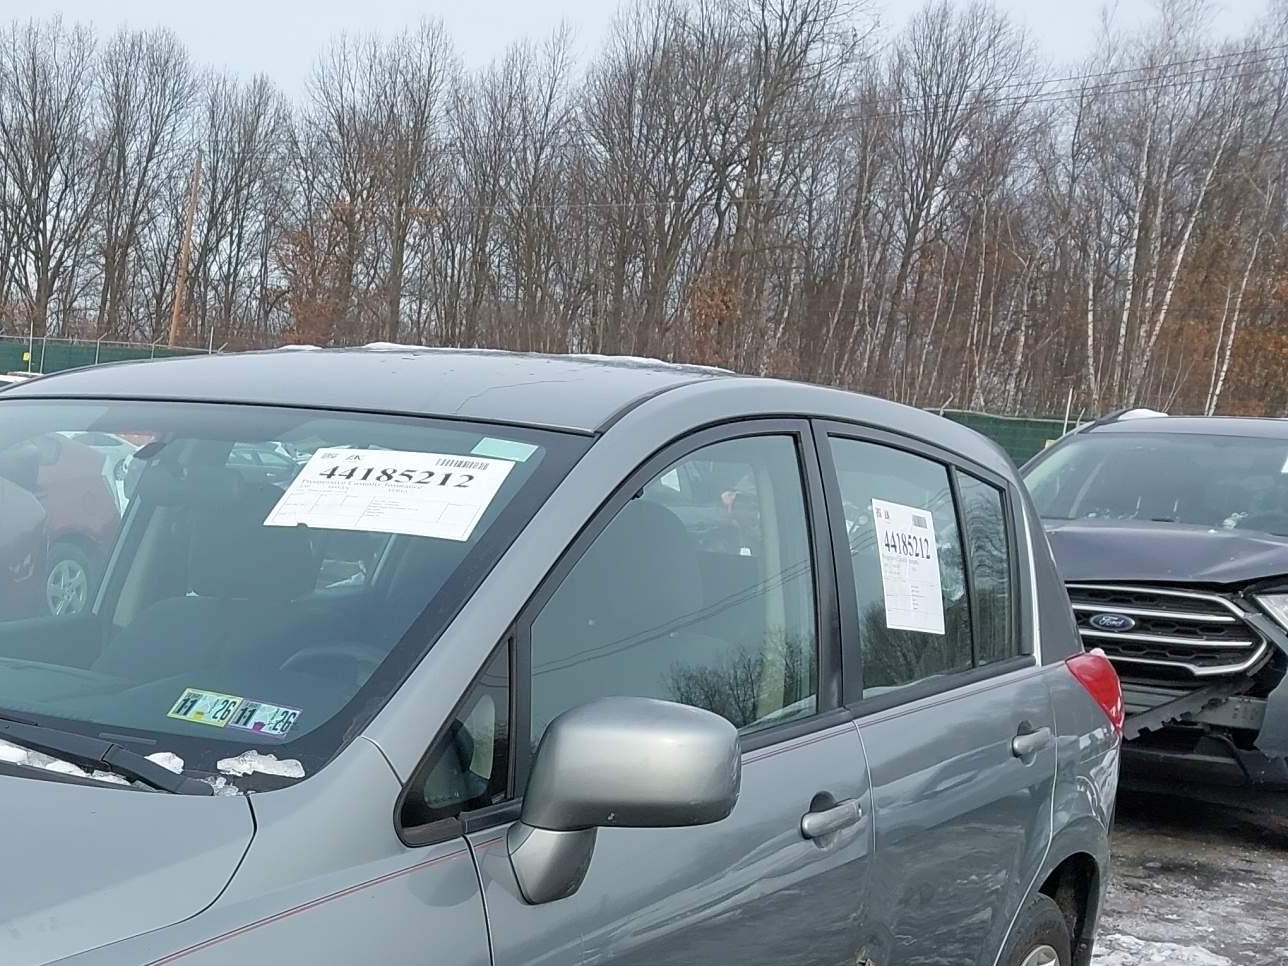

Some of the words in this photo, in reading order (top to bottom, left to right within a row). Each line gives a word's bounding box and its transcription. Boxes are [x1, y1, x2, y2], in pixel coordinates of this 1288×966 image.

[319, 465, 474, 488] 44185212
[884, 529, 931, 560] 44185212
[1099, 615, 1125, 627] Ford
[176, 697, 199, 716] 11
[212, 699, 237, 721] 26
[234, 707, 257, 726] 11
[272, 710, 297, 733] 26
